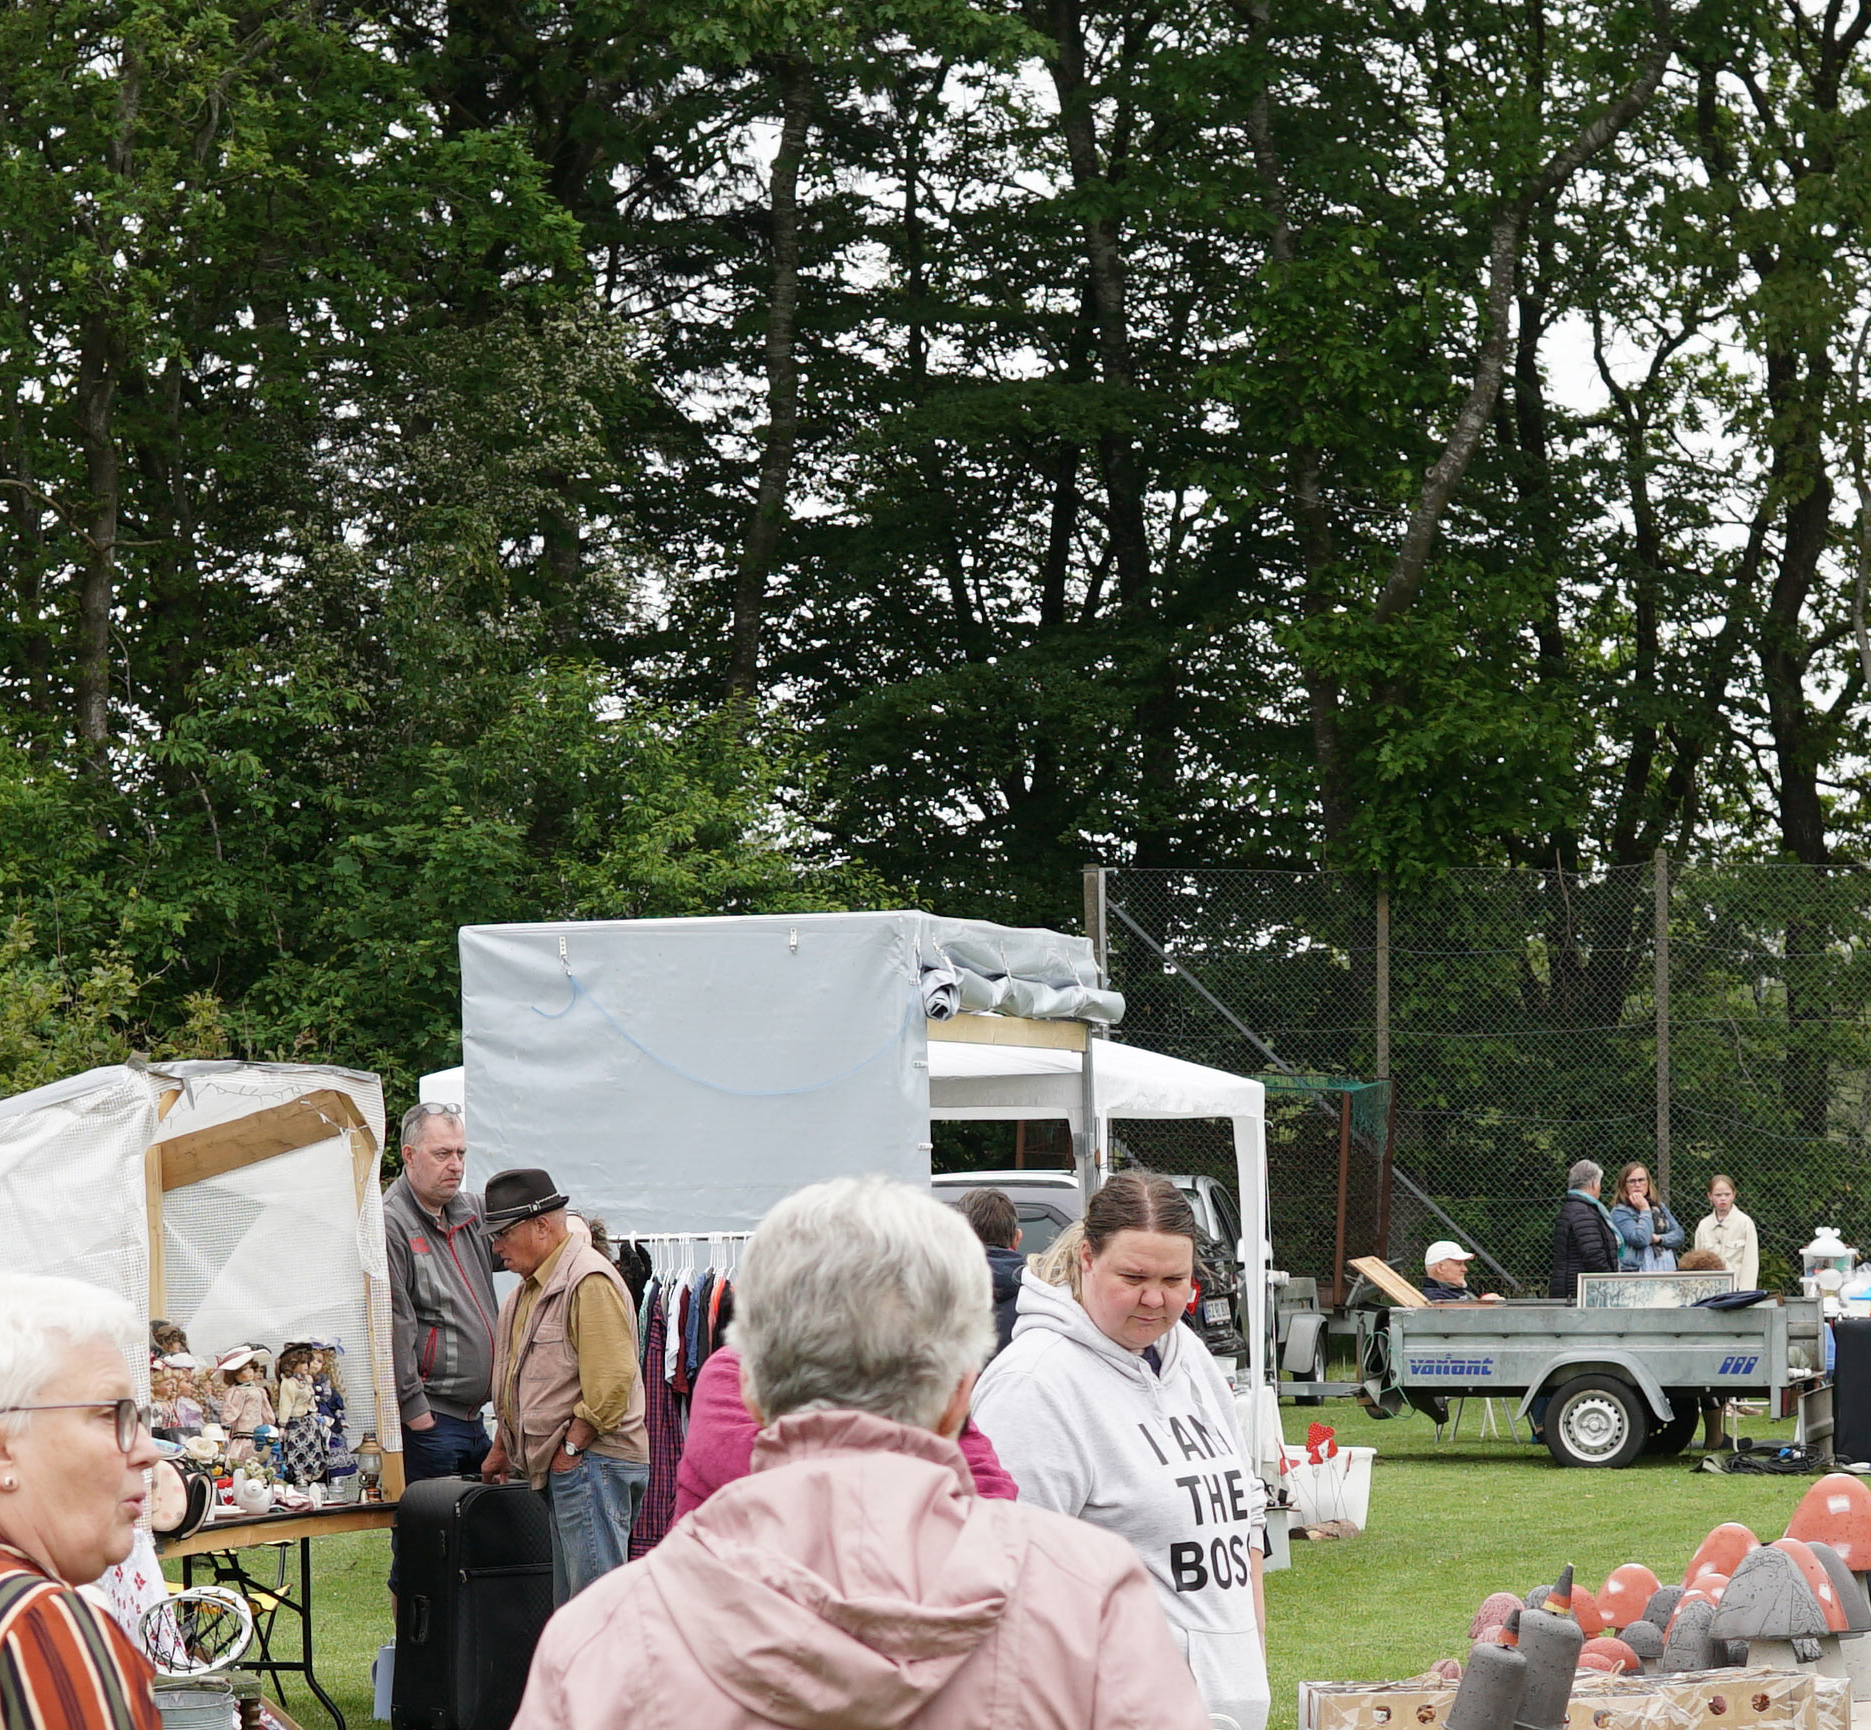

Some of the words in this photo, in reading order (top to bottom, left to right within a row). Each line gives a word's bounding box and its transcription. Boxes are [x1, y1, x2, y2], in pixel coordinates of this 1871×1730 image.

[1138, 1423, 1169, 1466] I
[1174, 1469, 1249, 1526] THE
[1170, 1532, 1251, 1592] BOS
